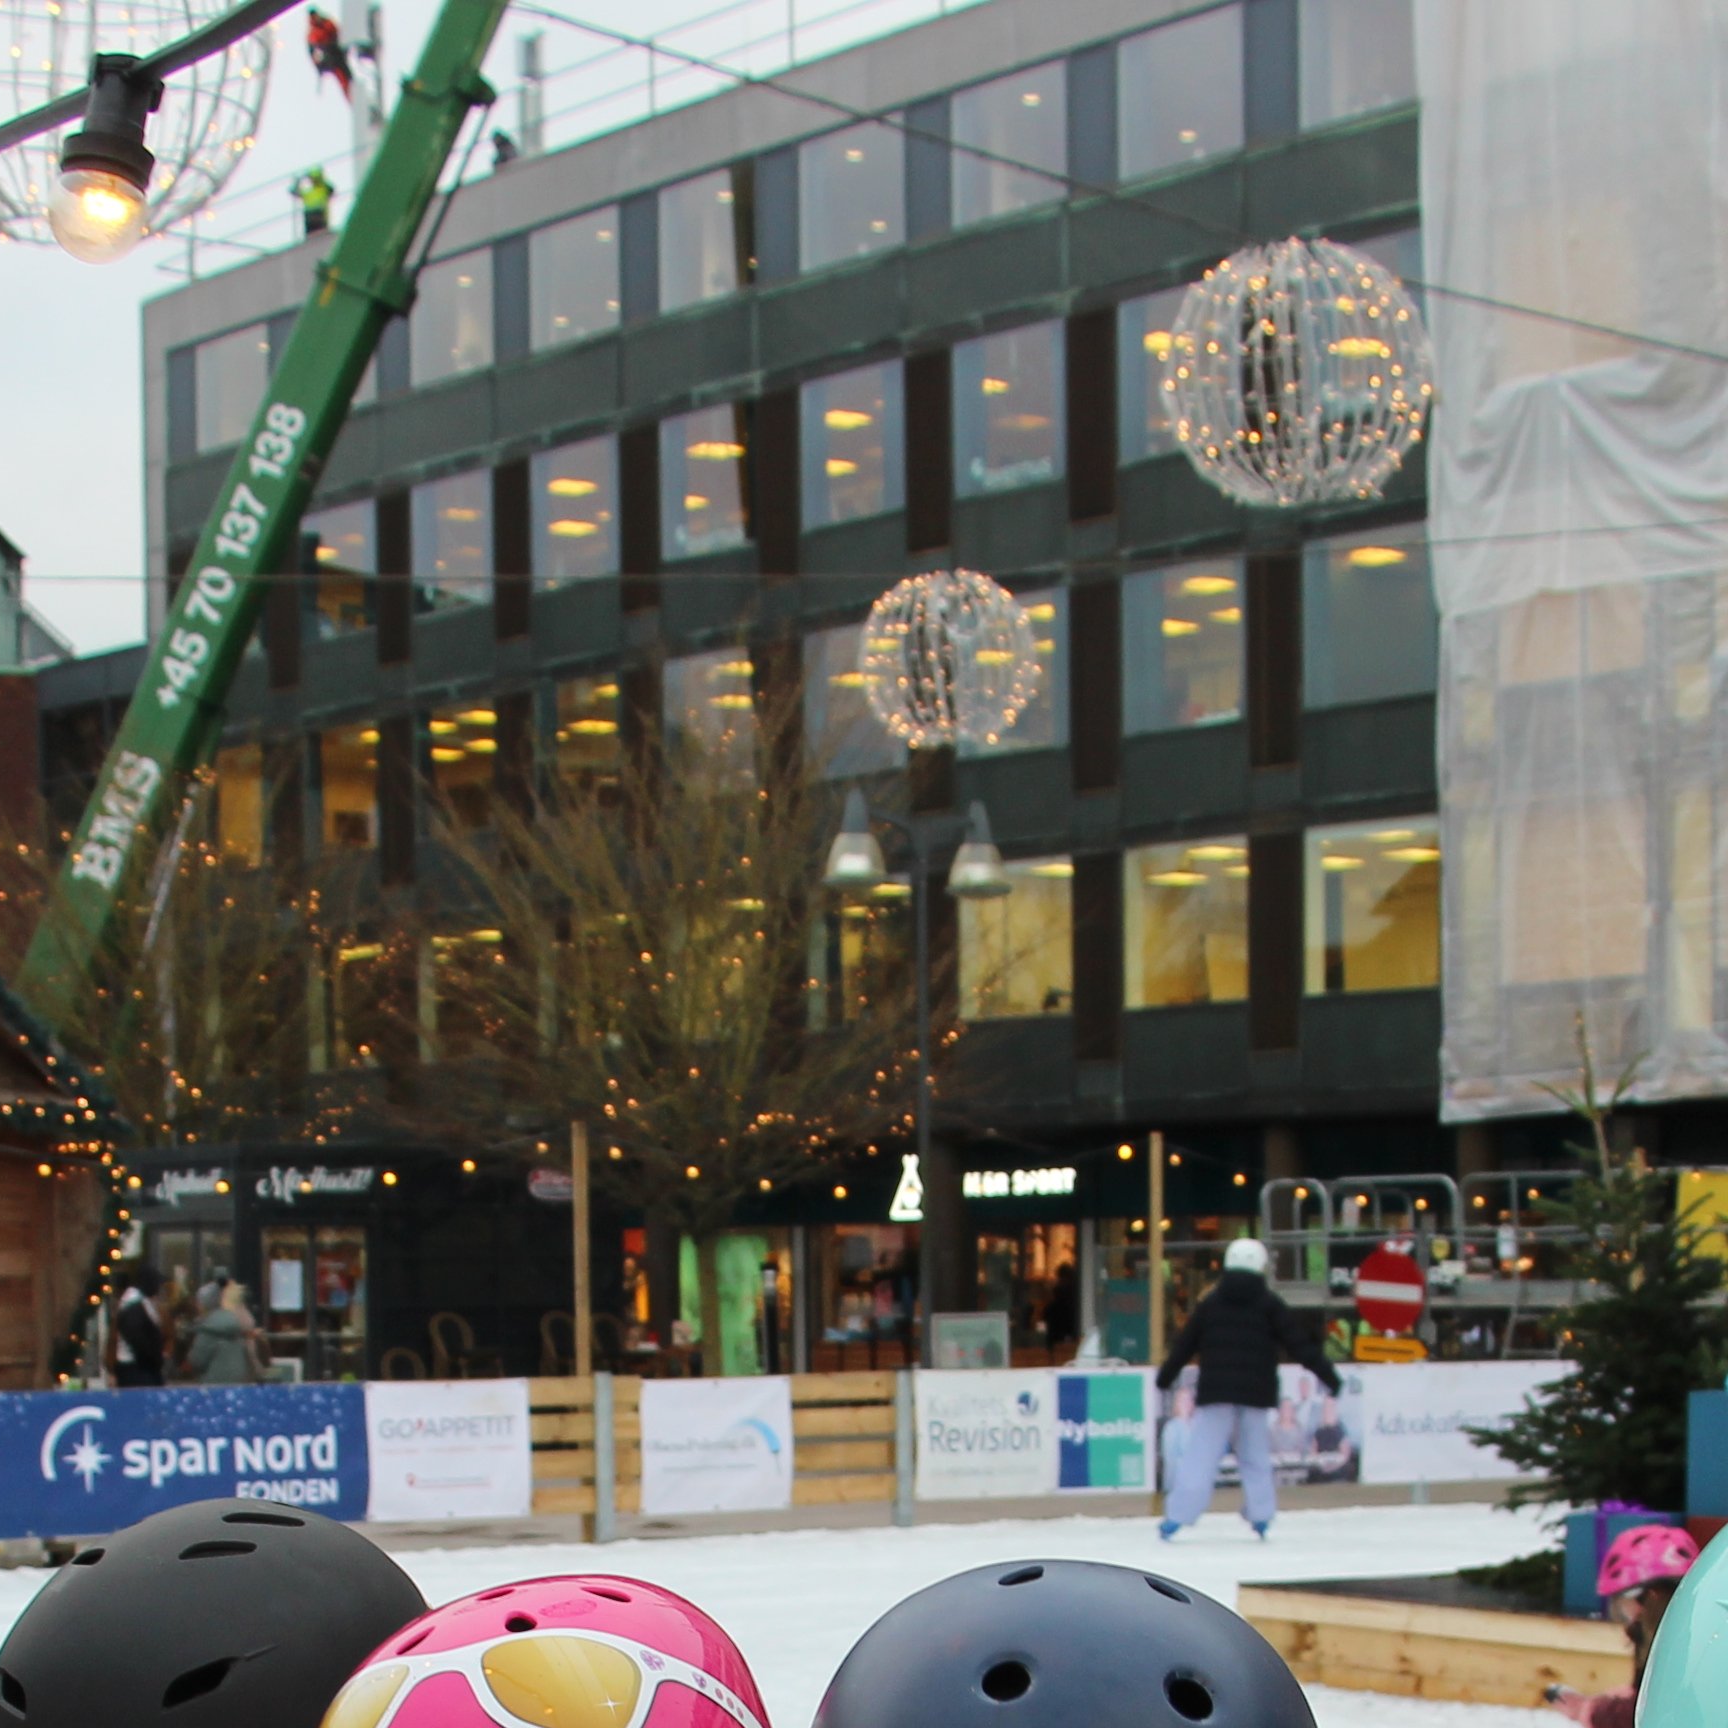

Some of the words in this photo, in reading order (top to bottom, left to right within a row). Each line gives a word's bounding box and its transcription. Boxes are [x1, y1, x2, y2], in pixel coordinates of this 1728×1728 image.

[157, 627, 210, 709] +45
[184, 565, 236, 626] 70
[215, 482, 268, 560] 137
[248, 402, 306, 479] 138
[122, 1436, 229, 1488] spar
[234, 1424, 339, 1474] Nord
[928, 1420, 1042, 1452] Revision
[236, 1478, 340, 1506] FONDEN
